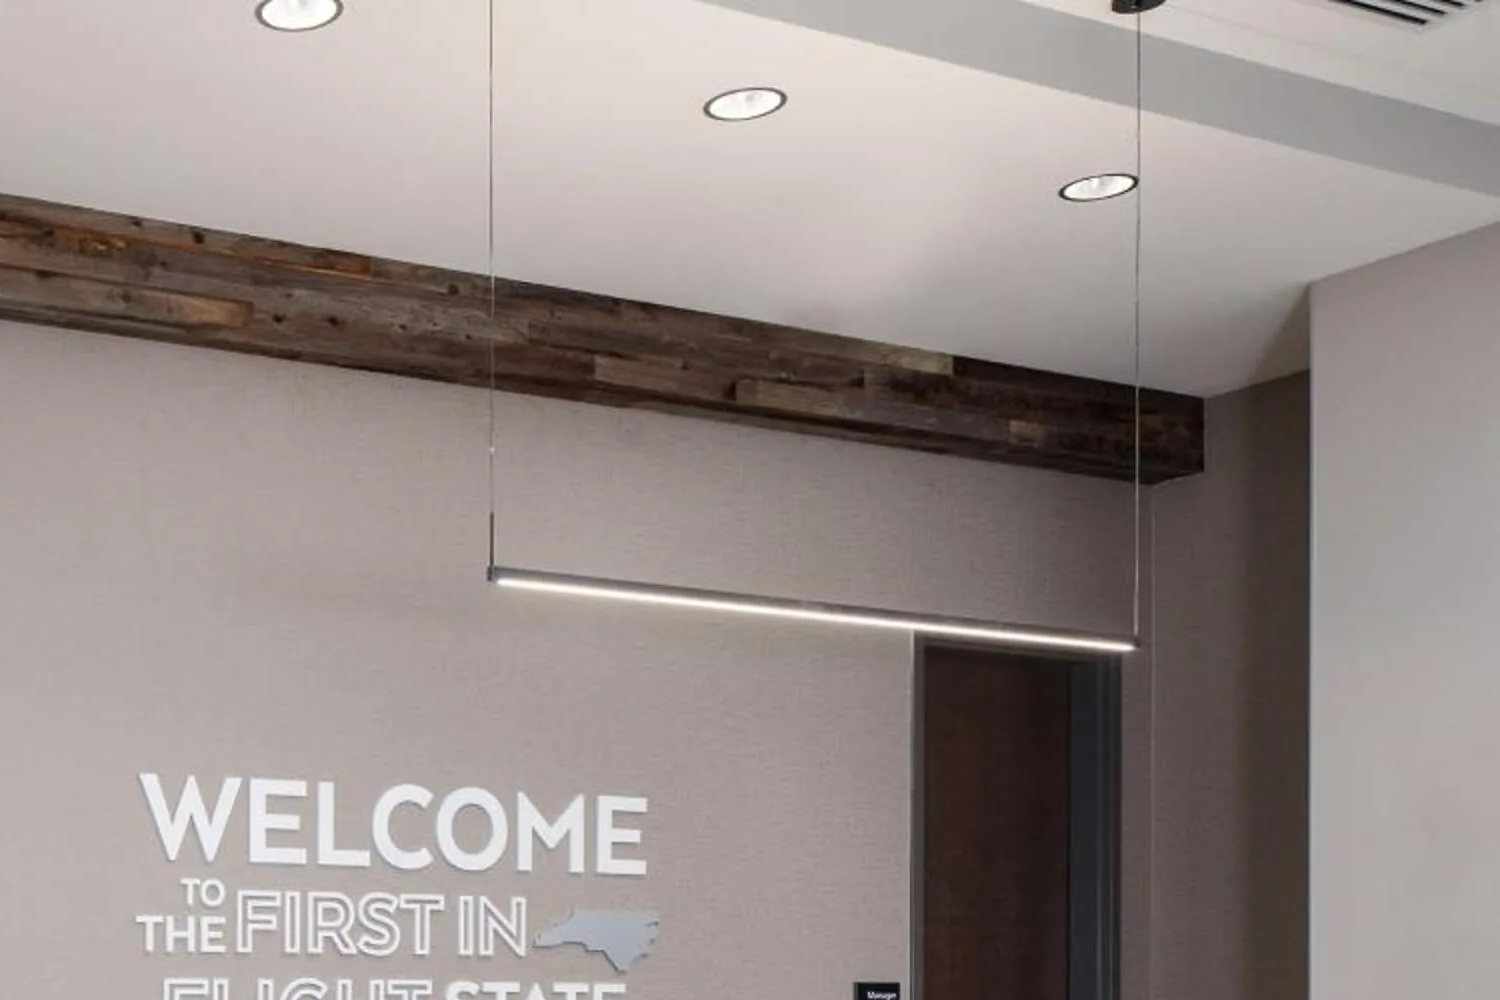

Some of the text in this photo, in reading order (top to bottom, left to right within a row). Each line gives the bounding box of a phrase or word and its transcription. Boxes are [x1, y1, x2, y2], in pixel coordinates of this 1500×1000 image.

[139, 772, 648, 875] WELCOME
[136, 890, 527, 957] THE FIRST IN
[180, 878, 226, 907] TO
